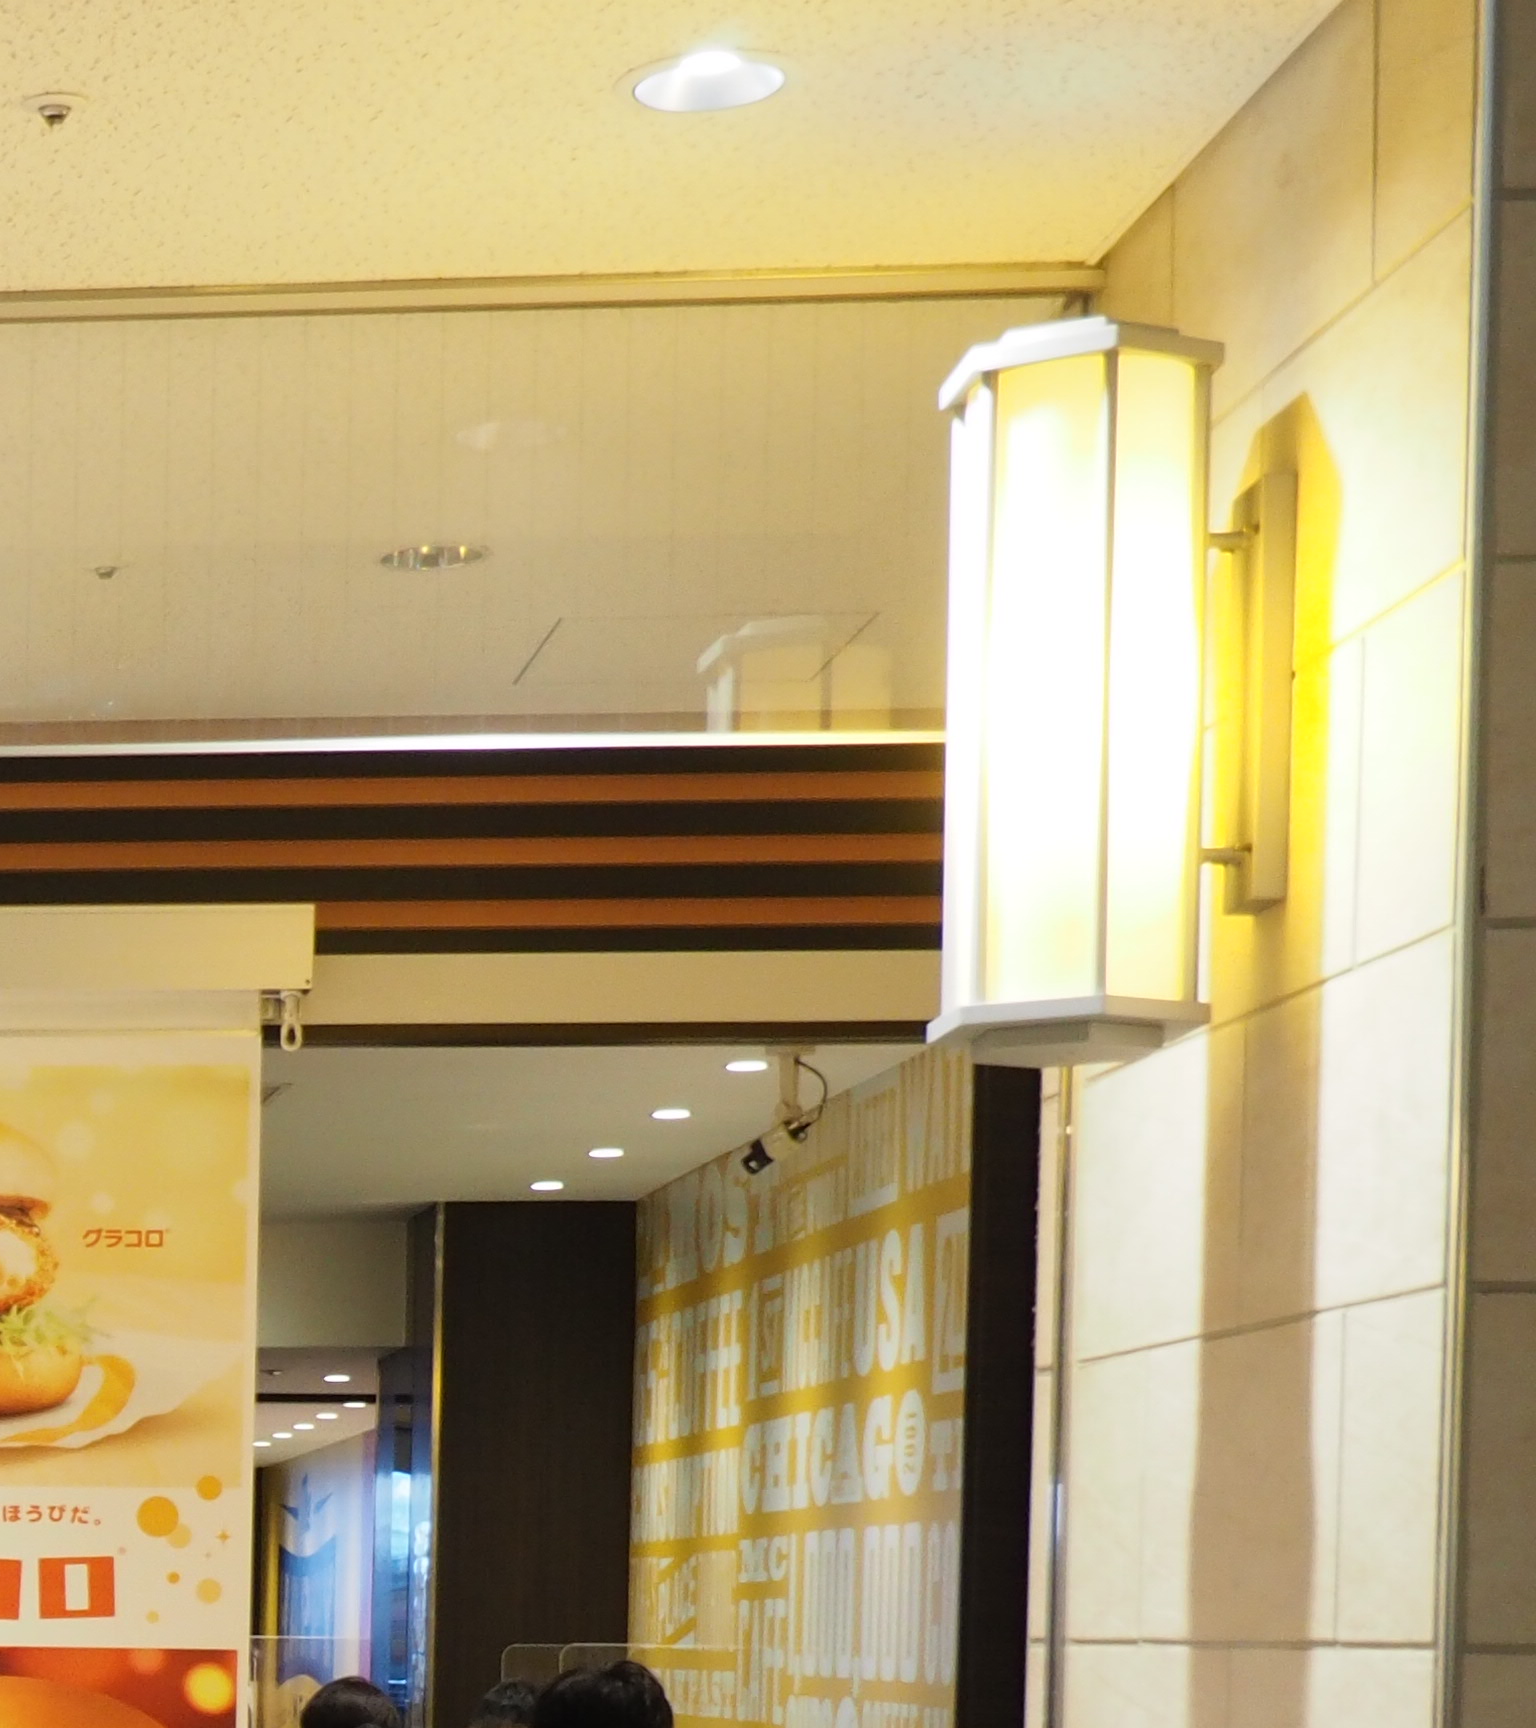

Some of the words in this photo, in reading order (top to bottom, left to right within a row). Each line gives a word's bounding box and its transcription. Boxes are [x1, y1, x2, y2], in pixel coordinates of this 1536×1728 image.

[82, 1227, 164, 1249] グラコロ
[854, 1222, 925, 1379] USA
[740, 1388, 926, 1515] CHICAGO
